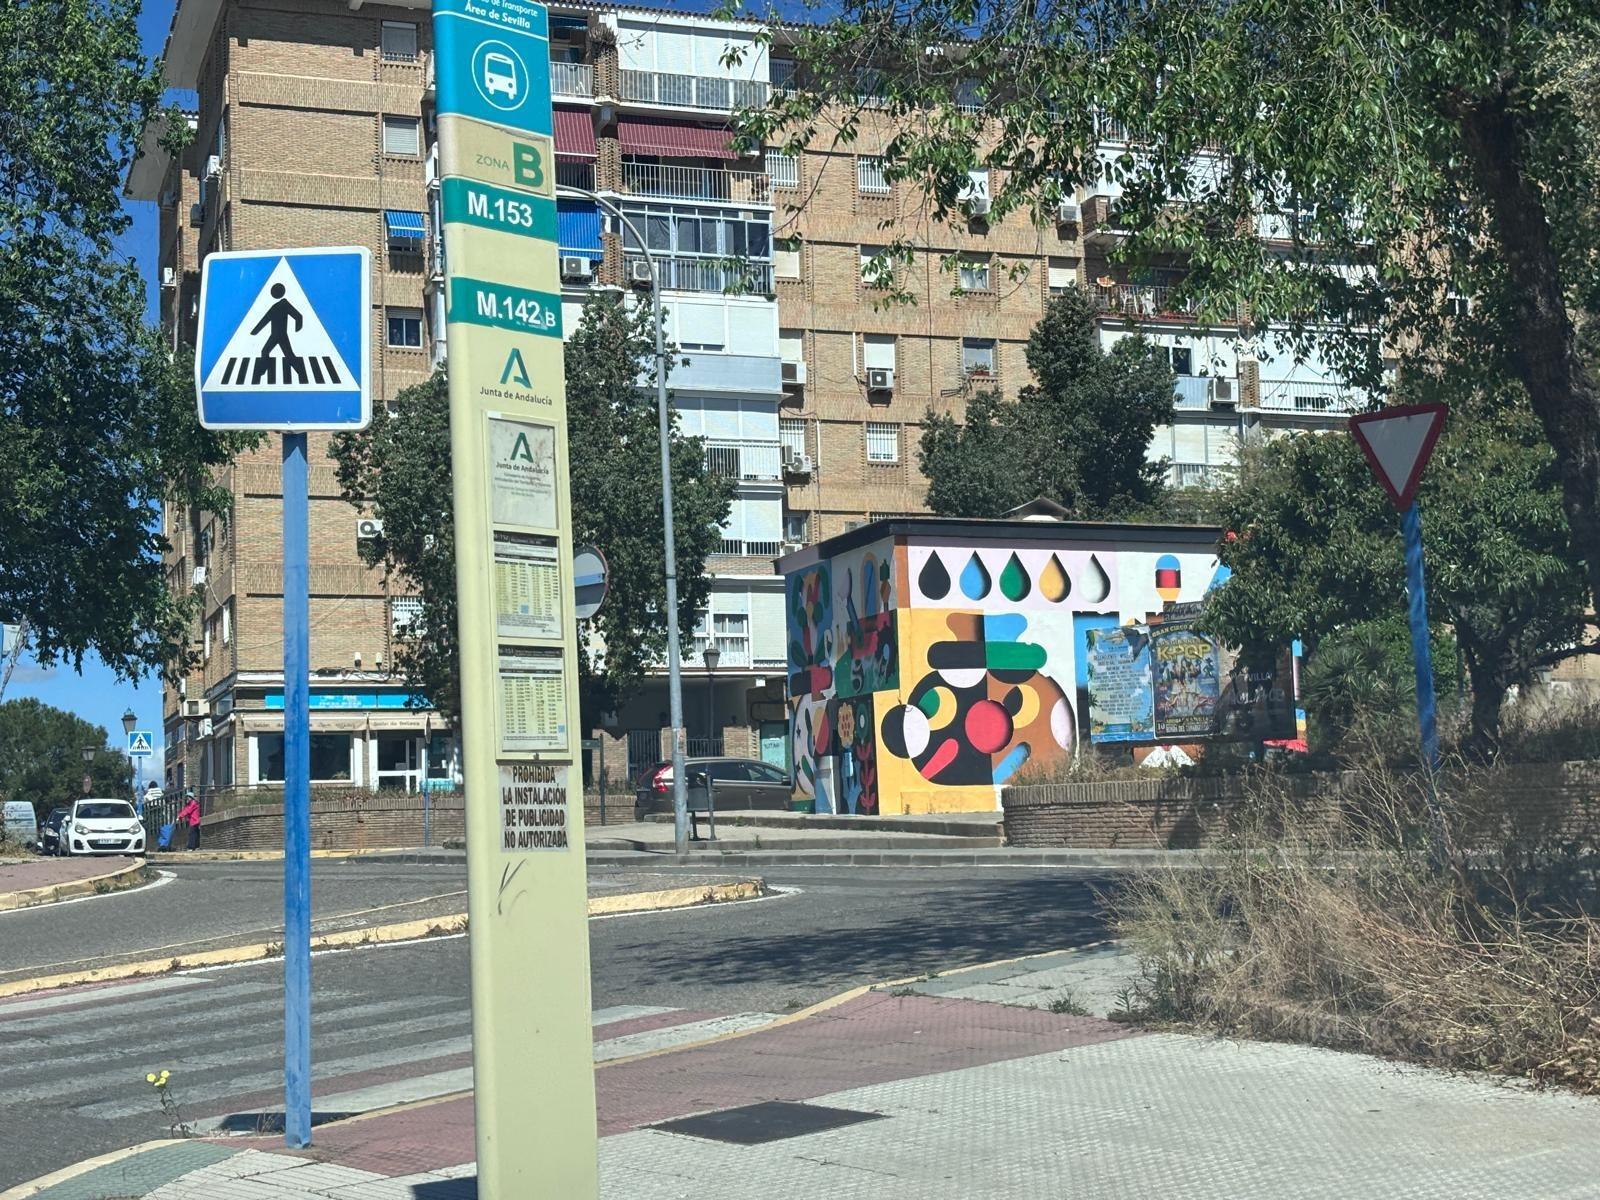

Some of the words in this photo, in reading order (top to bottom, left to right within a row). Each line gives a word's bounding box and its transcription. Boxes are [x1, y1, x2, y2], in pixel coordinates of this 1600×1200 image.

[502, 0, 538, 17] Transporte
[489, 9, 500, 20] de
[502, 13, 531, 28] Sevilla
[476, 154, 509, 171] ZONA
[512, 141, 544, 188] B
[468, 191, 533, 228] M.153
[480, 386, 502, 398] Junta
[504, 390, 513, 400] de
[515, 392, 552, 406] Andalucía
[496, 461, 512, 471] Junta
[512, 765, 556, 783] PROHIBIDA
[502, 787, 513, 805] LA
[514, 783, 567, 805] INSTALACIÓN
[505, 809, 517, 827] DE
[518, 809, 565, 827] PUBLICIDAD
[504, 831, 516, 848] NO
[518, 830, 568, 849] AUTORIZADA
